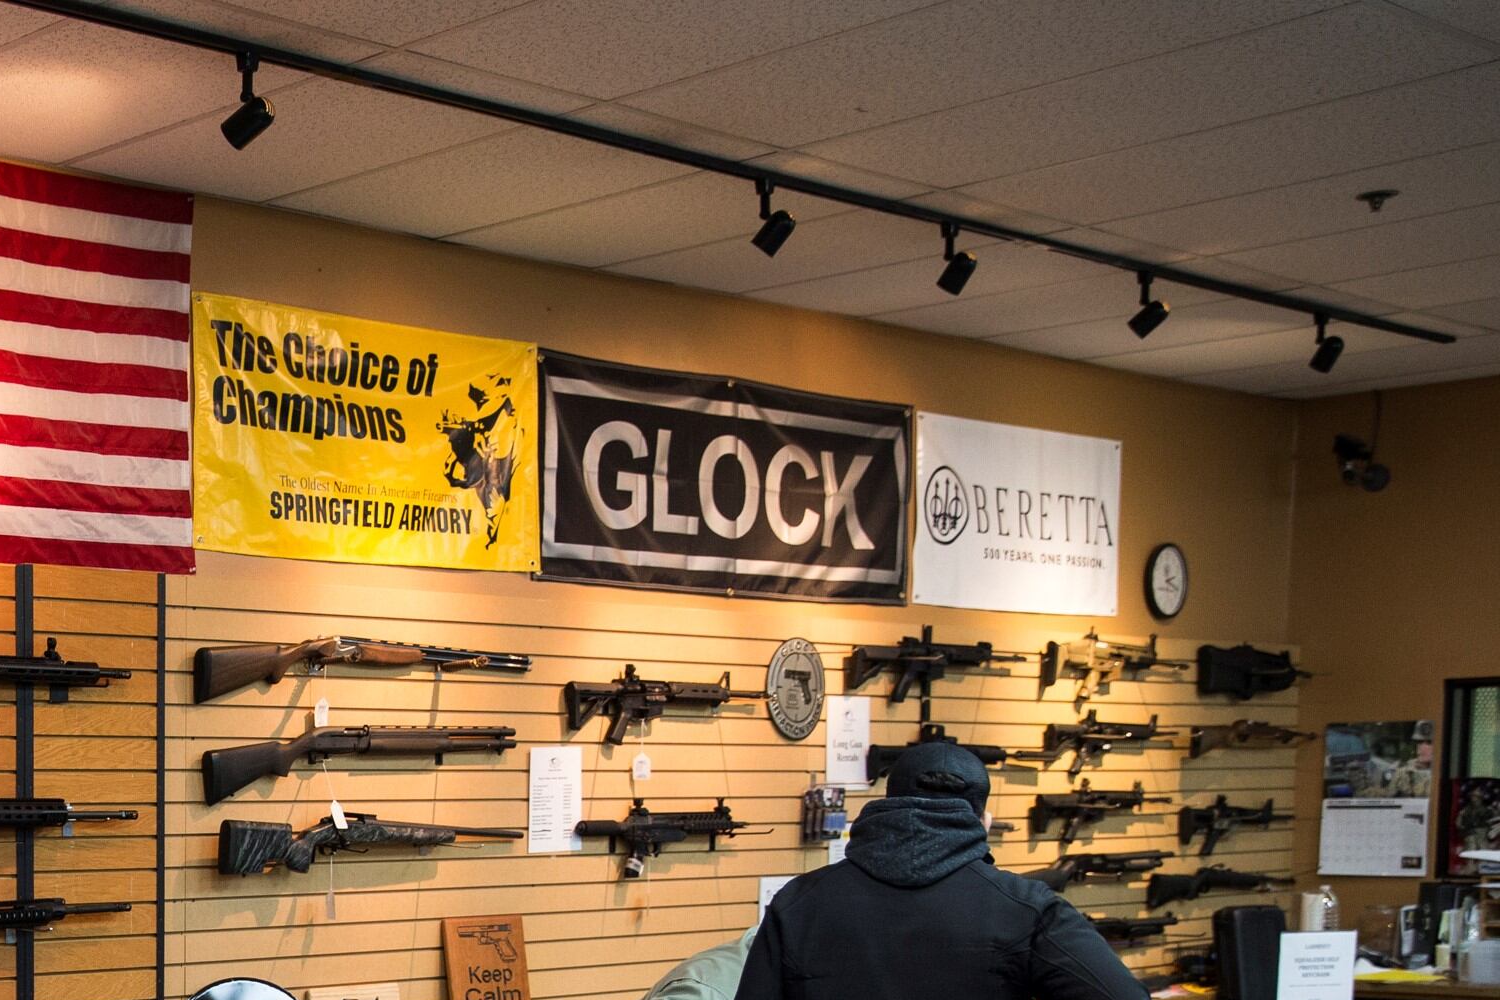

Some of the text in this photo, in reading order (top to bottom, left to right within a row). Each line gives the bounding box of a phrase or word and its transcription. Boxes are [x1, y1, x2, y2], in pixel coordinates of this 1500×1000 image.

[210, 319, 439, 398] The Choice of
[212, 374, 407, 443] Champions
[279, 475, 458, 503] The Oldest Name In American Firearms
[582, 420, 875, 551] GLOCK
[269, 491, 472, 535] SPRINGFIELD ARMORY
[972, 485, 1113, 546] BERETTA
[983, 547, 1105, 569] 500 YEARS. ONE PASSION.
[468, 966, 513, 986] Keep
